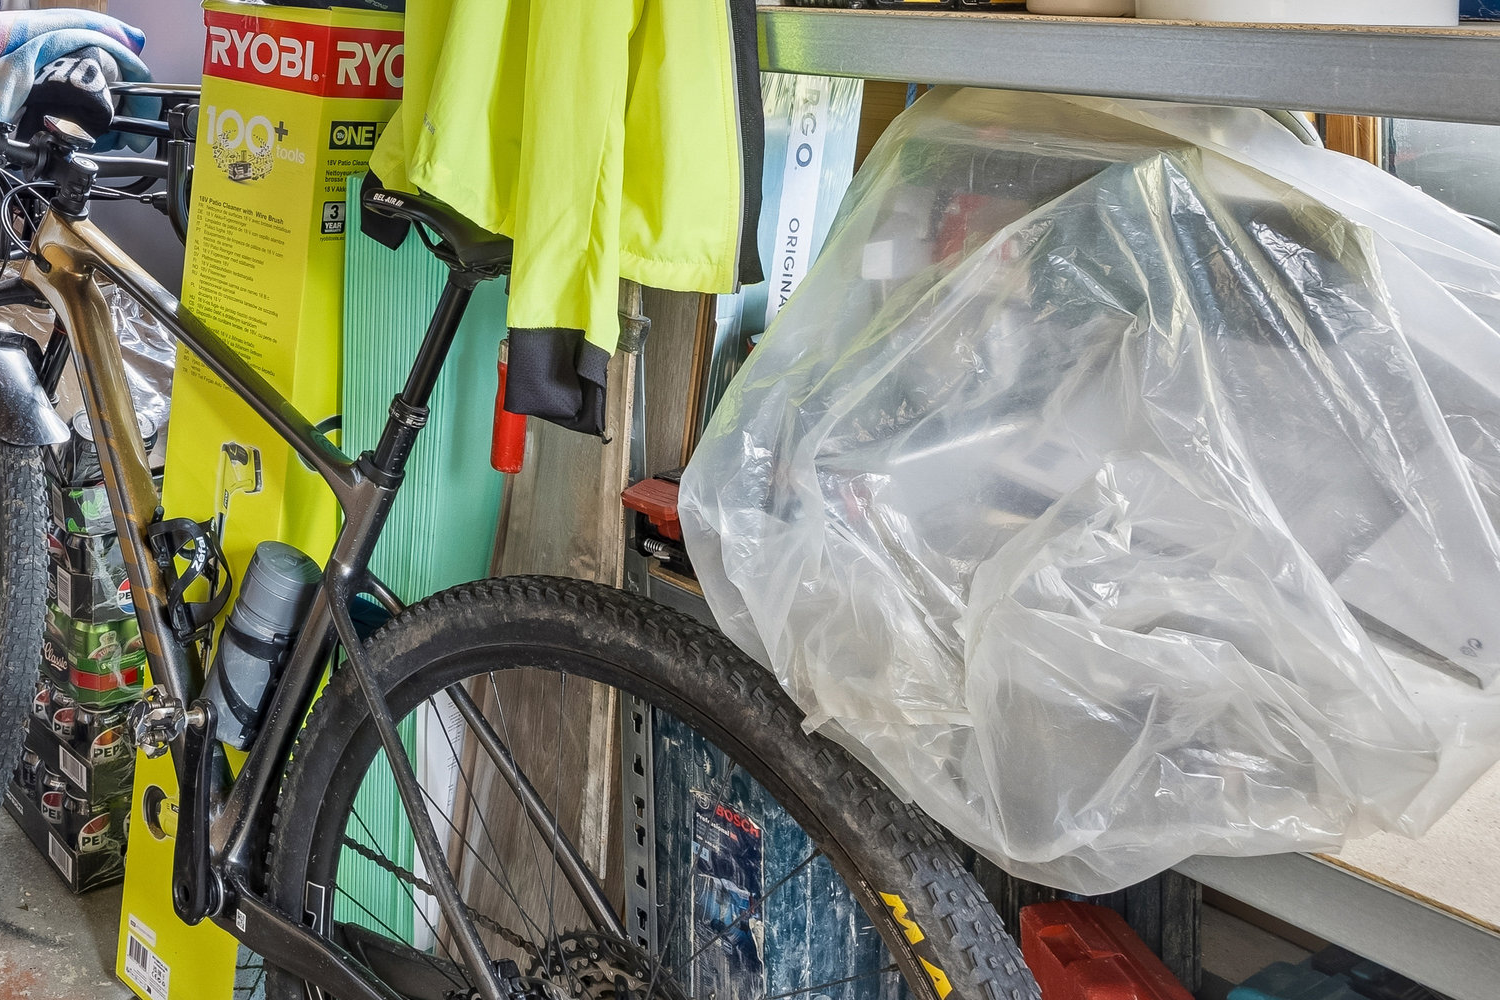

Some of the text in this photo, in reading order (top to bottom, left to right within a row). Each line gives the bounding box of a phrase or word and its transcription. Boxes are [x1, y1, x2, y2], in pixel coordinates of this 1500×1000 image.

[210, 26, 314, 81] RYOBI
[337, 41, 404, 88] RYO
[333, 125, 374, 146] ONE
[276, 145, 305, 165] tools
[209, 198, 221, 207] Patio
[223, 200, 241, 212] Cleaner
[243, 206, 253, 216] with
[255, 211, 267, 220] Wire
[268, 214, 284, 225] Brush
[329, 204, 339, 219] 3
[778, 217, 800, 312] ORIGINA
[716, 804, 760, 838] BOSCH
[879, 891, 953, 1000] MA
